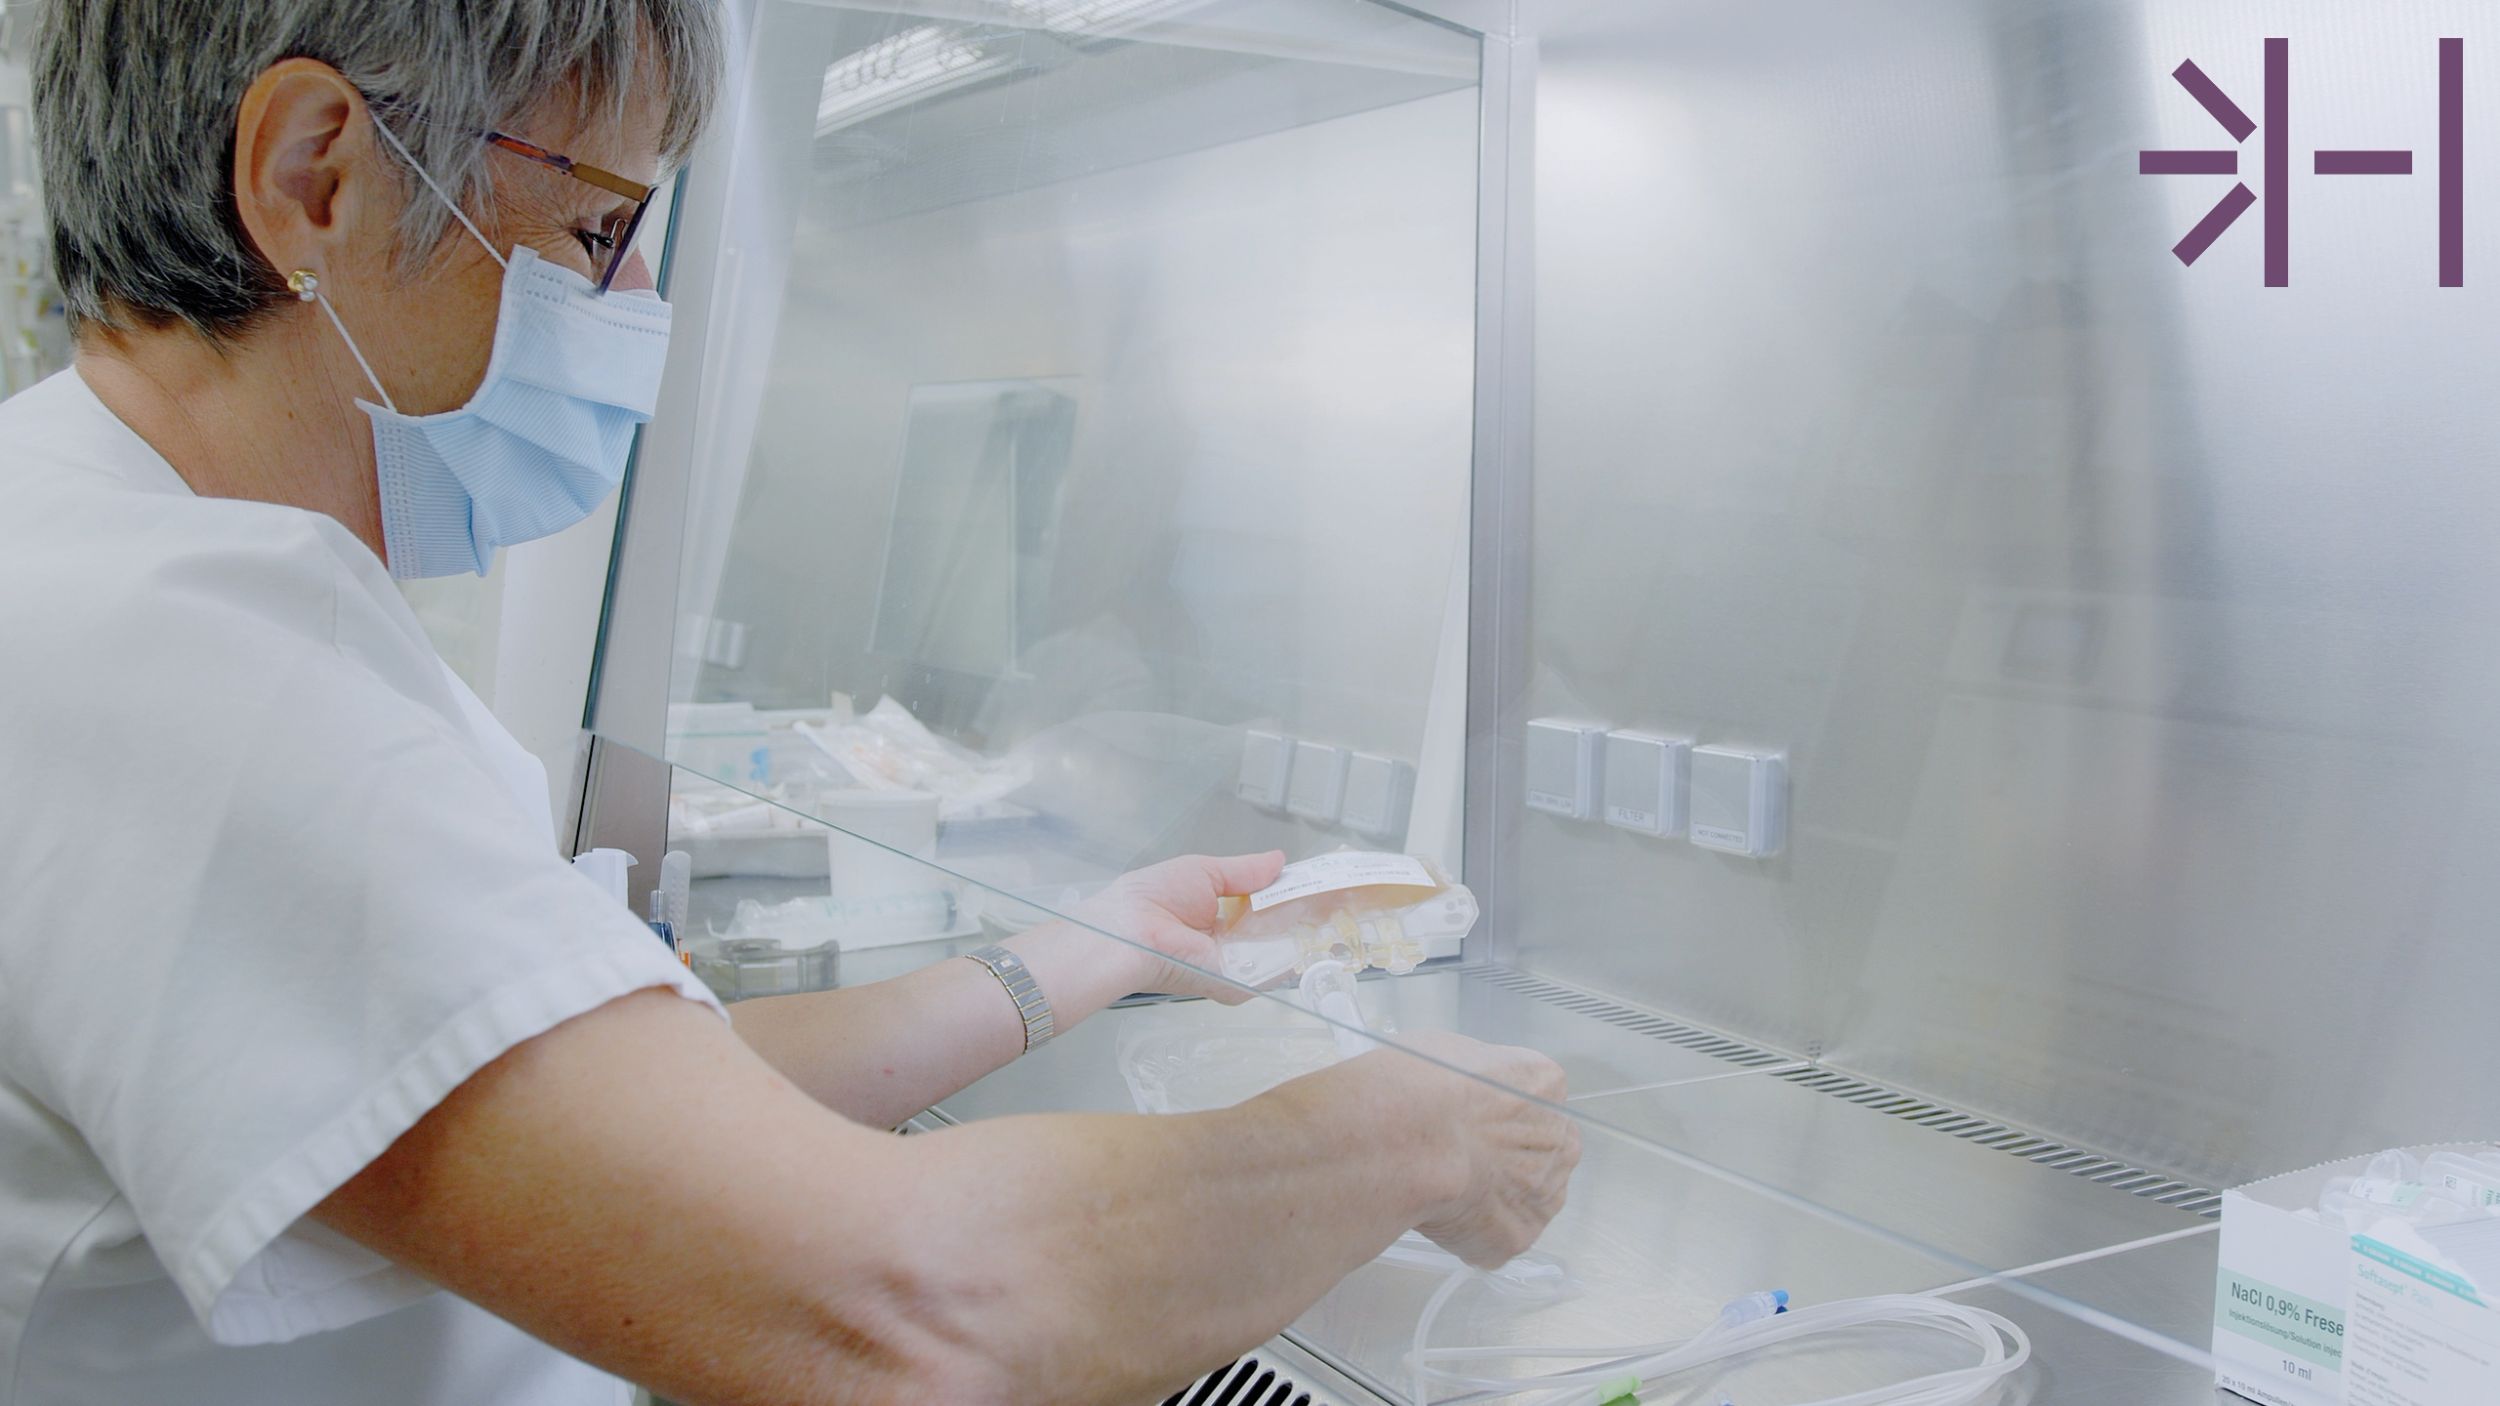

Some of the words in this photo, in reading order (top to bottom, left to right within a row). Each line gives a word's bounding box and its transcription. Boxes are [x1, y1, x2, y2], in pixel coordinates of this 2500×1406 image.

[1618, 808, 1645, 822] FILTER
[2231, 1282, 2262, 1307] NaCl
[2266, 1295, 2301, 1321] 0,9%
[2304, 1308, 2344, 1336] Frese
[2281, 1359, 2295, 1374] 10
[2298, 1367, 2312, 1381] ml
